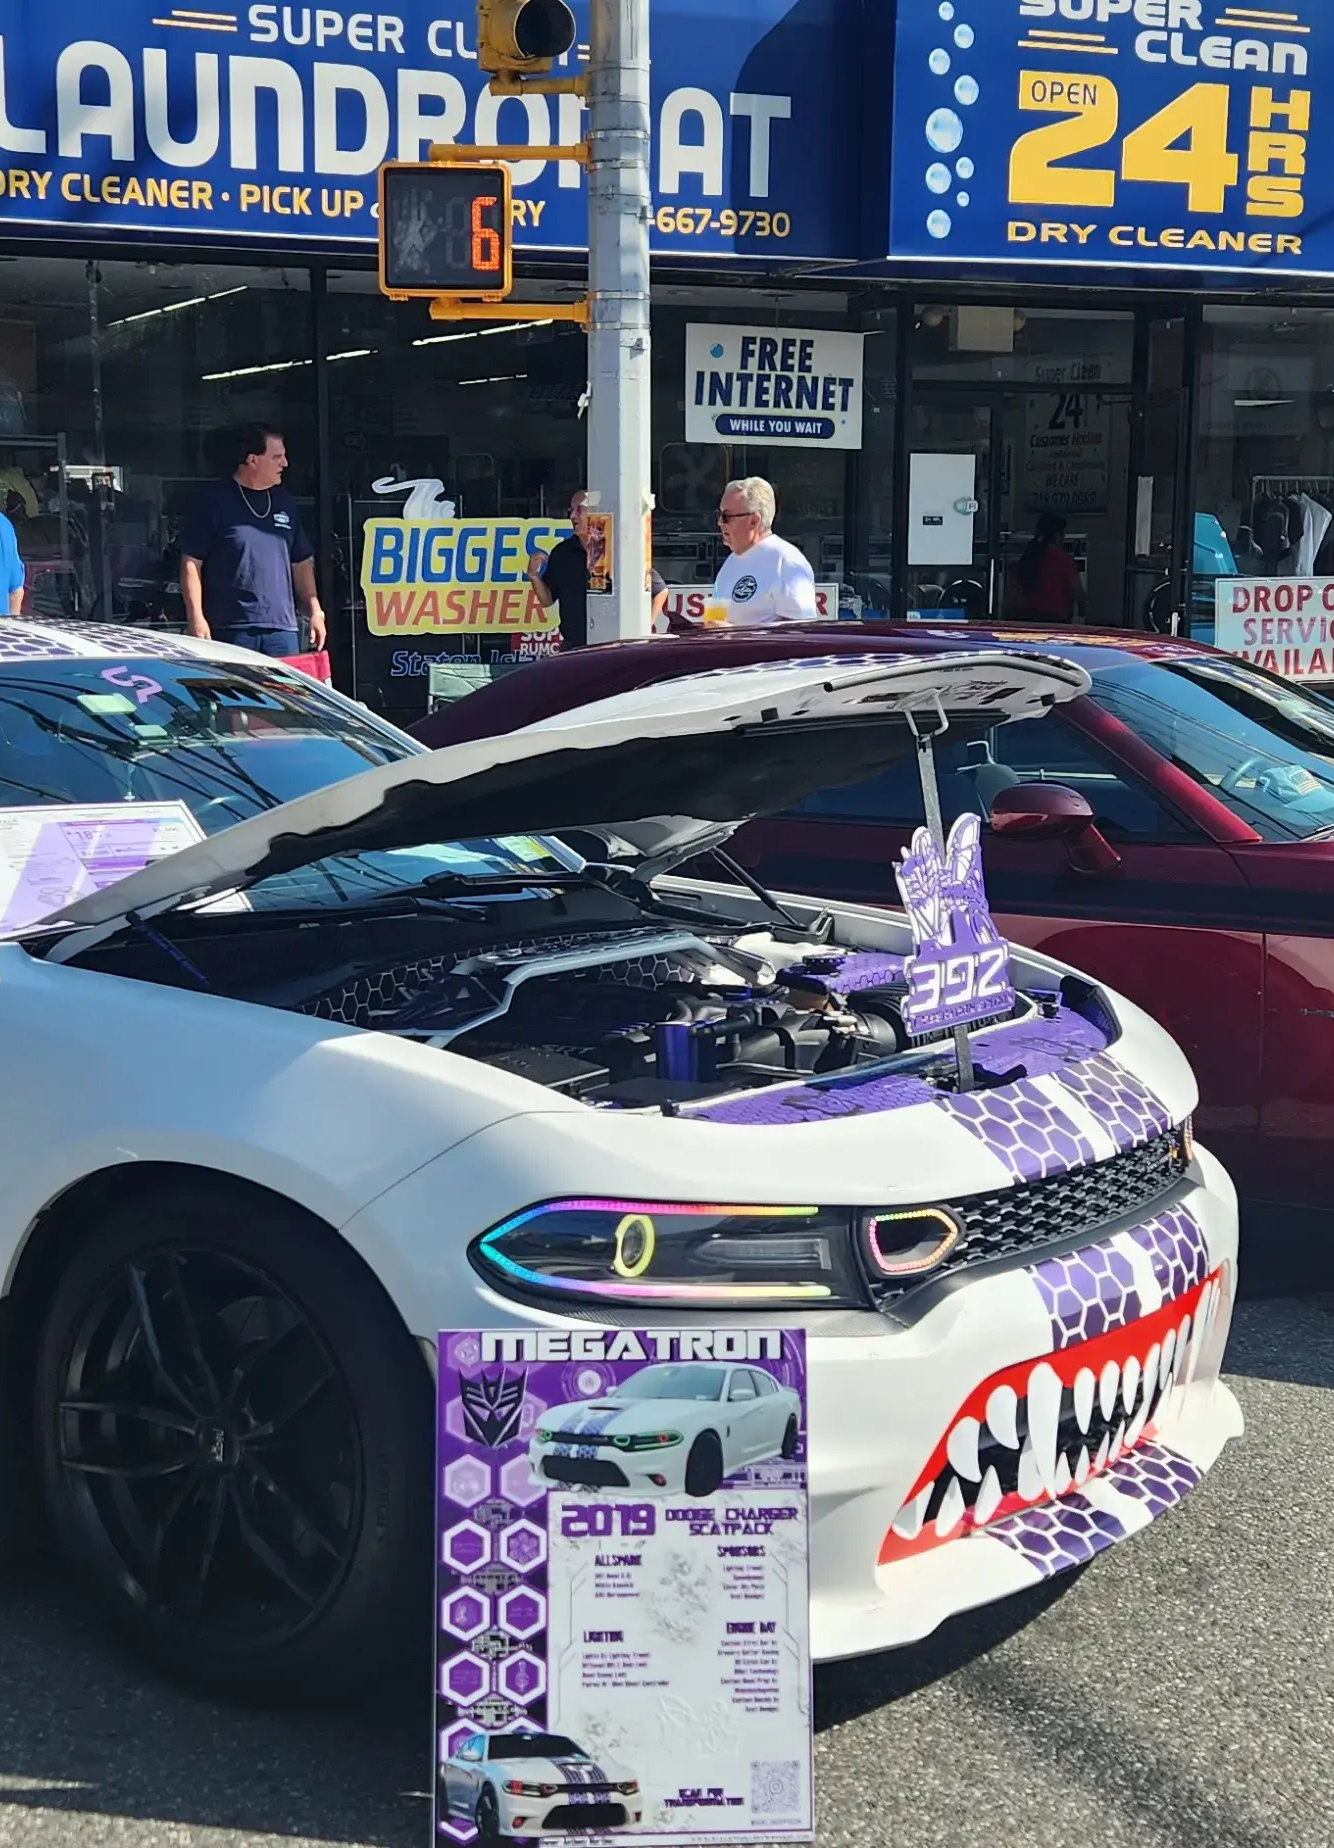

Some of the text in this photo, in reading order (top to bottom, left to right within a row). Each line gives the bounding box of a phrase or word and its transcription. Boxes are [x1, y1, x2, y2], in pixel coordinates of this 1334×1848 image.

[248, 4, 405, 54] SUPER
[1135, 31, 1308, 76] CLEAN
[1031, 79, 1098, 106] OPEN
[1008, 69, 1239, 214] 24
[1246, 86, 1311, 218] HRS
[62, 172, 214, 210] CLEANER
[240, 184, 313, 216] PICK
[321, 189, 365, 219] UP
[470, 196, 501, 272] 6
[649, 204, 791, 238] -667-9730
[1007, 221, 1303, 256] DRY CLEANER
[739, 336, 815, 374] FREE
[694, 370, 855, 413] INTERNET
[729, 418, 823, 437] WHILE YOU WAIT
[1232, 584, 1315, 614] DROP
[909, 944, 1009, 1014] 392
[481, 1329, 782, 1362] MEGATRON
[560, 1504, 657, 1537] 2019
[689, 1522, 774, 1537] SCATPACK
[724, 1507, 799, 1521] CHARGER
